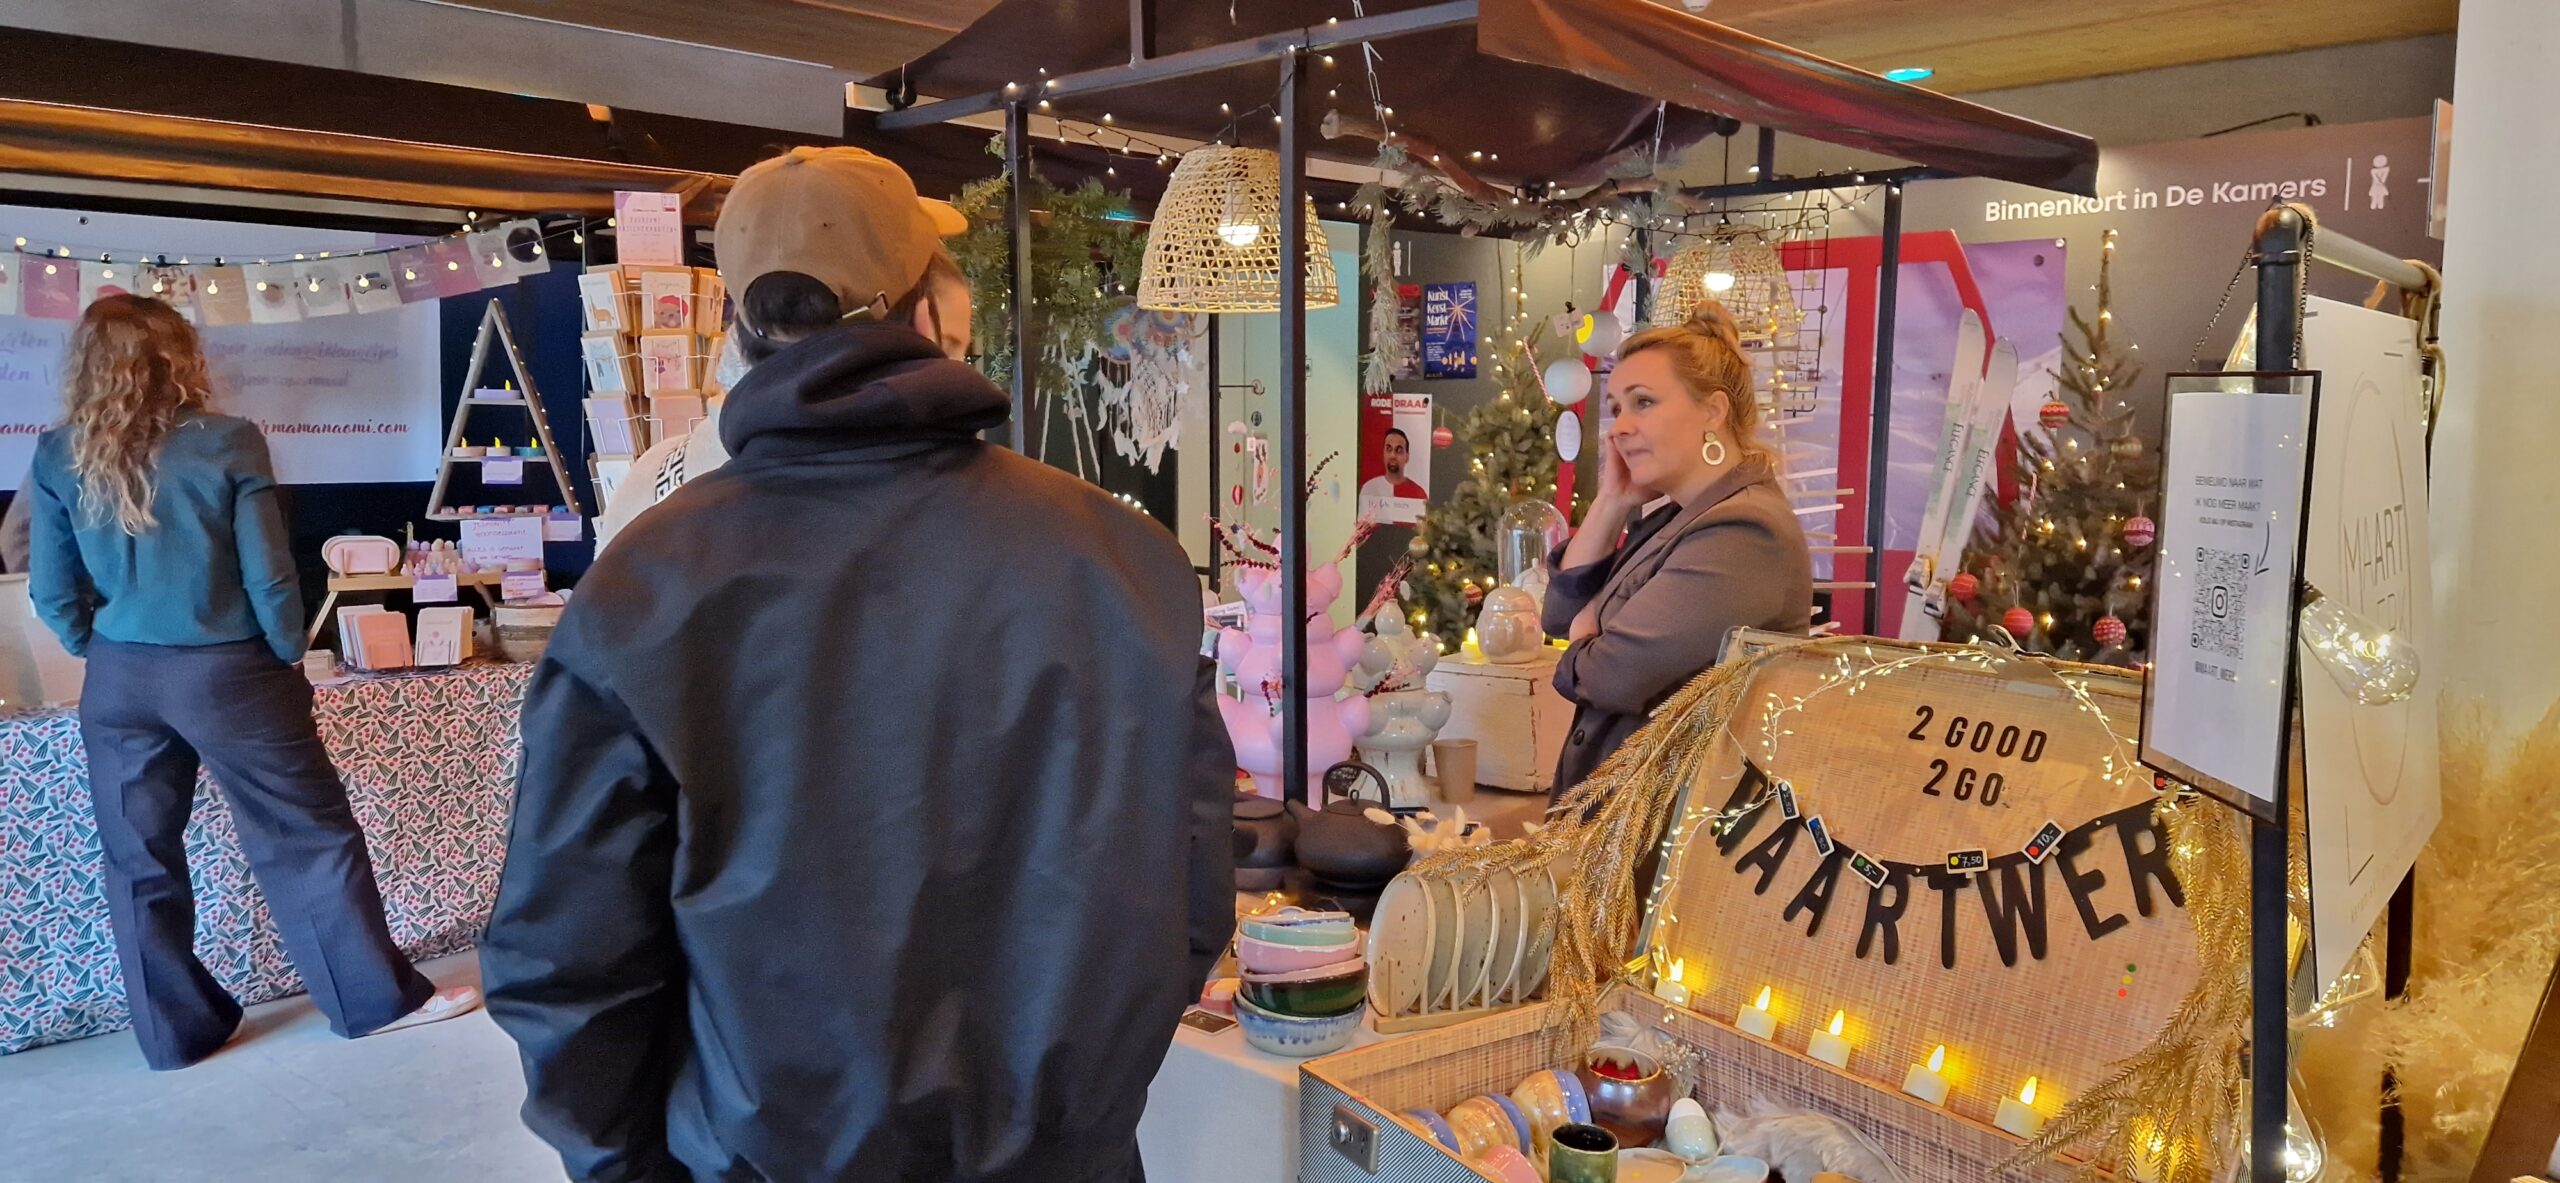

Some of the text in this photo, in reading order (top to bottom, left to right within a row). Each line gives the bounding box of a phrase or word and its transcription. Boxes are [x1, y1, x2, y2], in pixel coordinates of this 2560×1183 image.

[1985, 175, 2328, 223] Binnenkort in De Kamers
[1427, 290, 1449, 302] Kunst
[1427, 303, 1447, 314] Kerst
[1427, 314, 1449, 326] Markt
[1371, 398, 1392, 408] RODE
[2343, 503, 2404, 614] MAART
[1908, 704, 2048, 763] 2 GOOD
